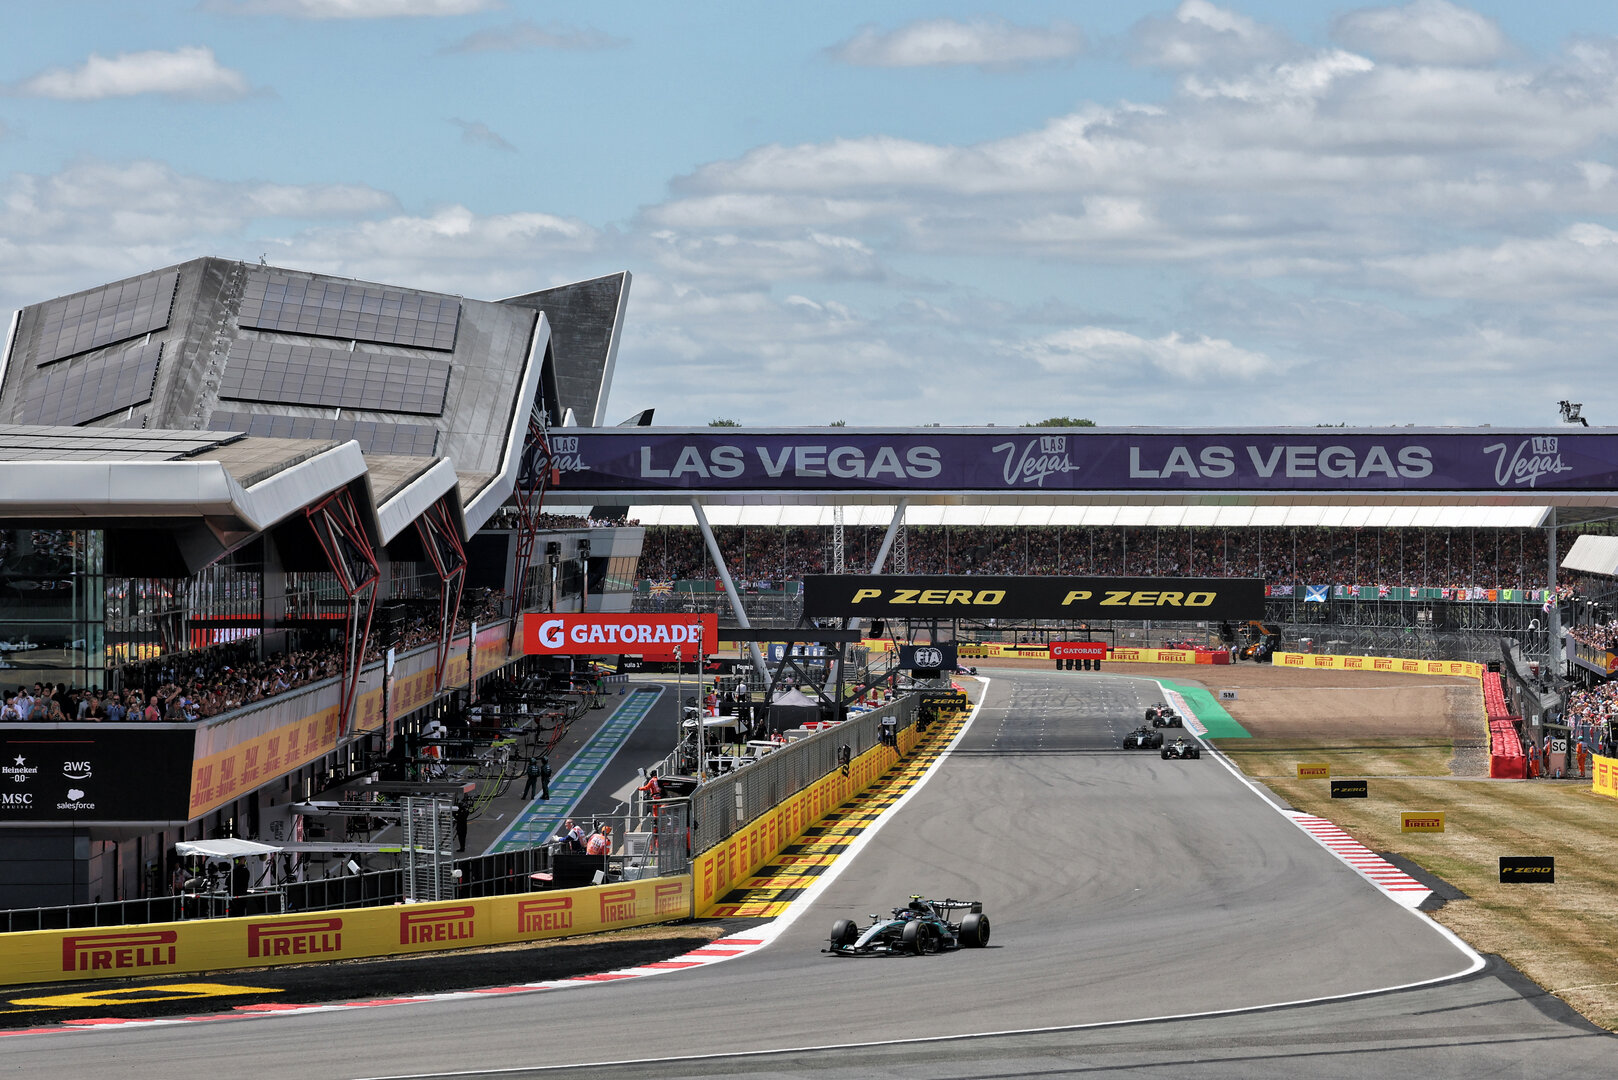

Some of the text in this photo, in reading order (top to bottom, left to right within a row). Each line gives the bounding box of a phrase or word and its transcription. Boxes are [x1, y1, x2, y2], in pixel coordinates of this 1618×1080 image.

[555, 439, 576, 451] LAS
[1042, 437, 1065, 452] LAS
[1534, 440, 1556, 452] LAS
[640, 446, 942, 479] LAS VEGAS
[992, 440, 1080, 487] Vegas
[1130, 445, 1434, 479] LAS VEGAS
[1483, 440, 1573, 488] Vegas
[851, 589, 1007, 605] P ZERO
[1061, 590, 1217, 607] P ZERO
[538, 619, 701, 648] G GATORADE
[1111, 651, 1139, 660] PIRELLI
[1158, 652, 1186, 662] PIRELLI
[1552, 741, 1566, 751] SC
[2, 766, 37, 774] Heineken
[63, 761, 91, 772] aws
[2, 793, 33, 804] MSC
[56, 801, 95, 811] salesforce
[1405, 818, 1440, 827] PIRELLI
[600, 888, 636, 923] PIRELLI
[518, 897, 572, 933] PIRELLI
[400, 906, 475, 944] PIRELLI
[247, 918, 343, 958] PIRELLI
[62, 930, 177, 972] PIRELLI
